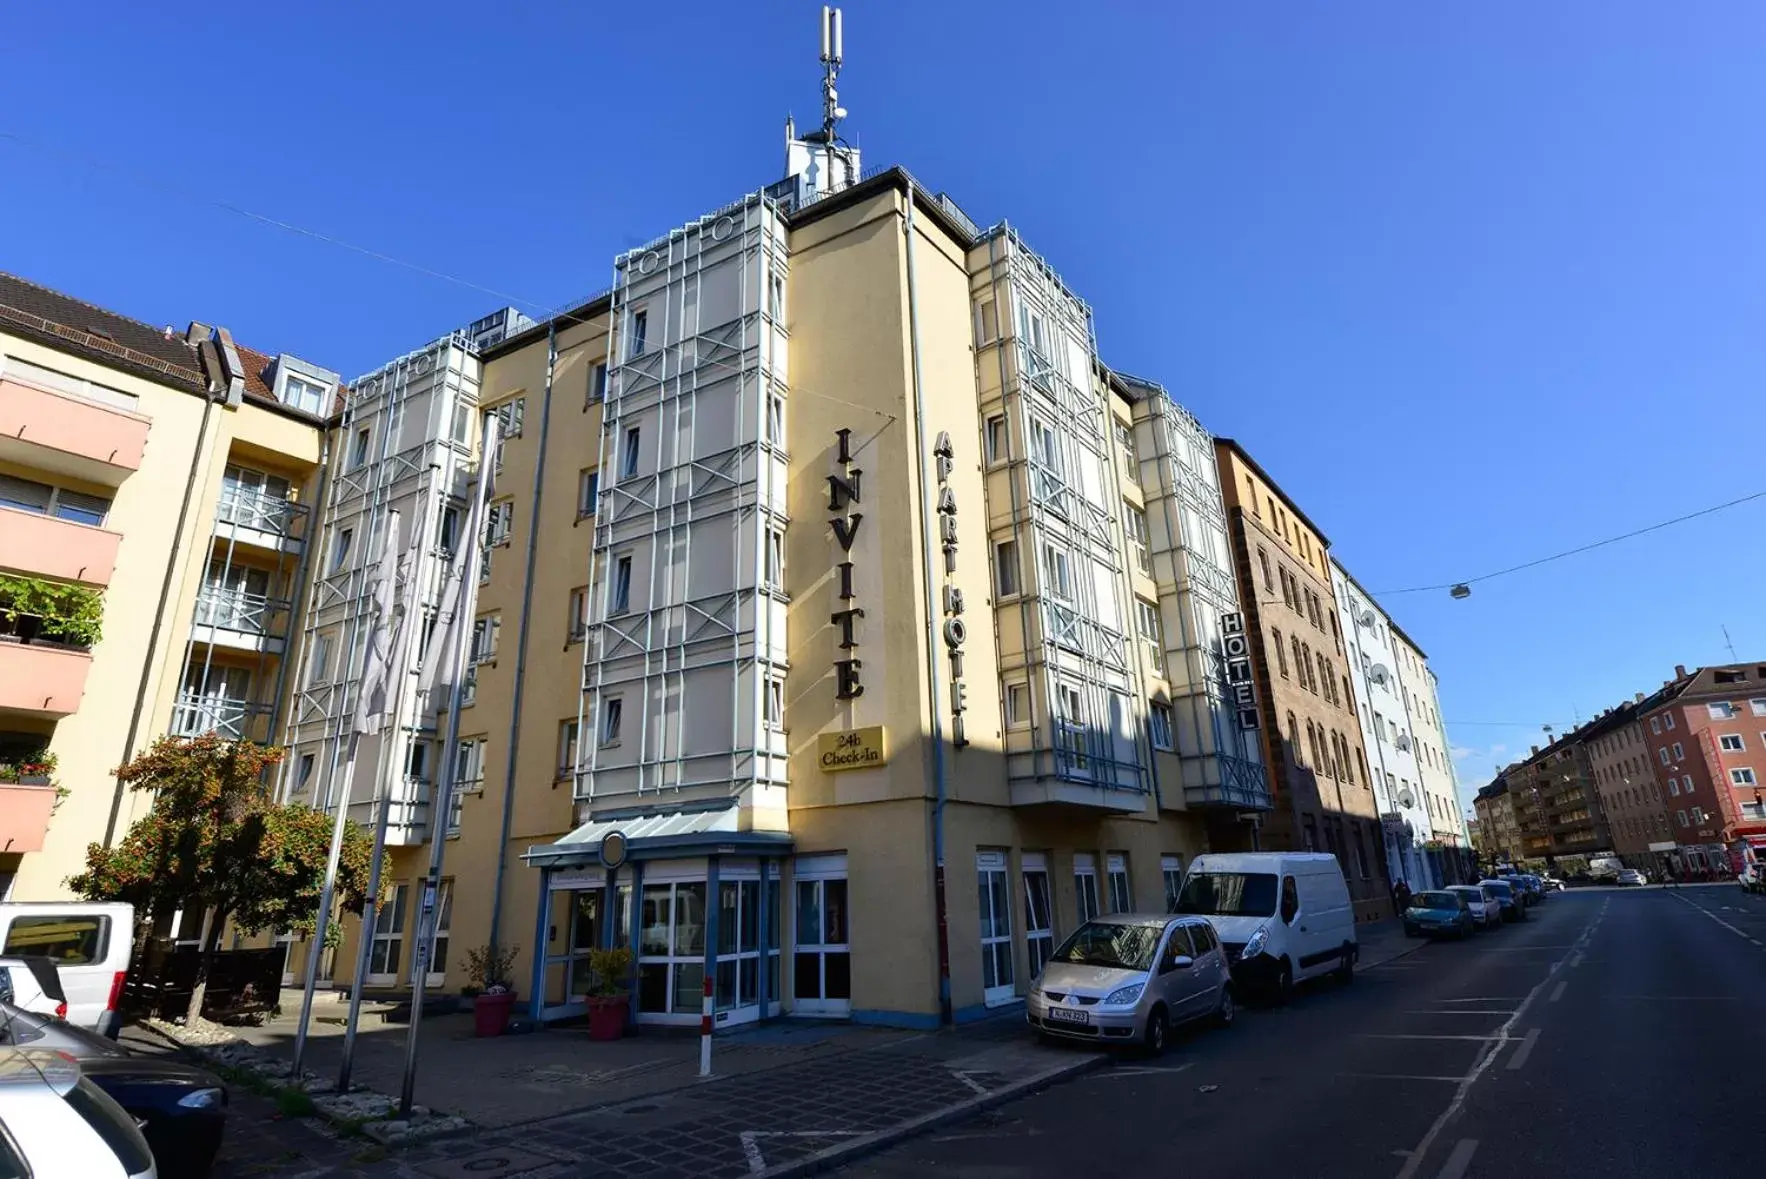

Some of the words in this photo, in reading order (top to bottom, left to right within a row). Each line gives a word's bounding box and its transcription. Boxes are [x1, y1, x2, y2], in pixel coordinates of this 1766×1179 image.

[826, 428, 864, 700] INVITE
[1223, 614, 1255, 729] HOTEL
[822, 747, 878, 766] Check-In
[838, 733, 861, 748] 24h
